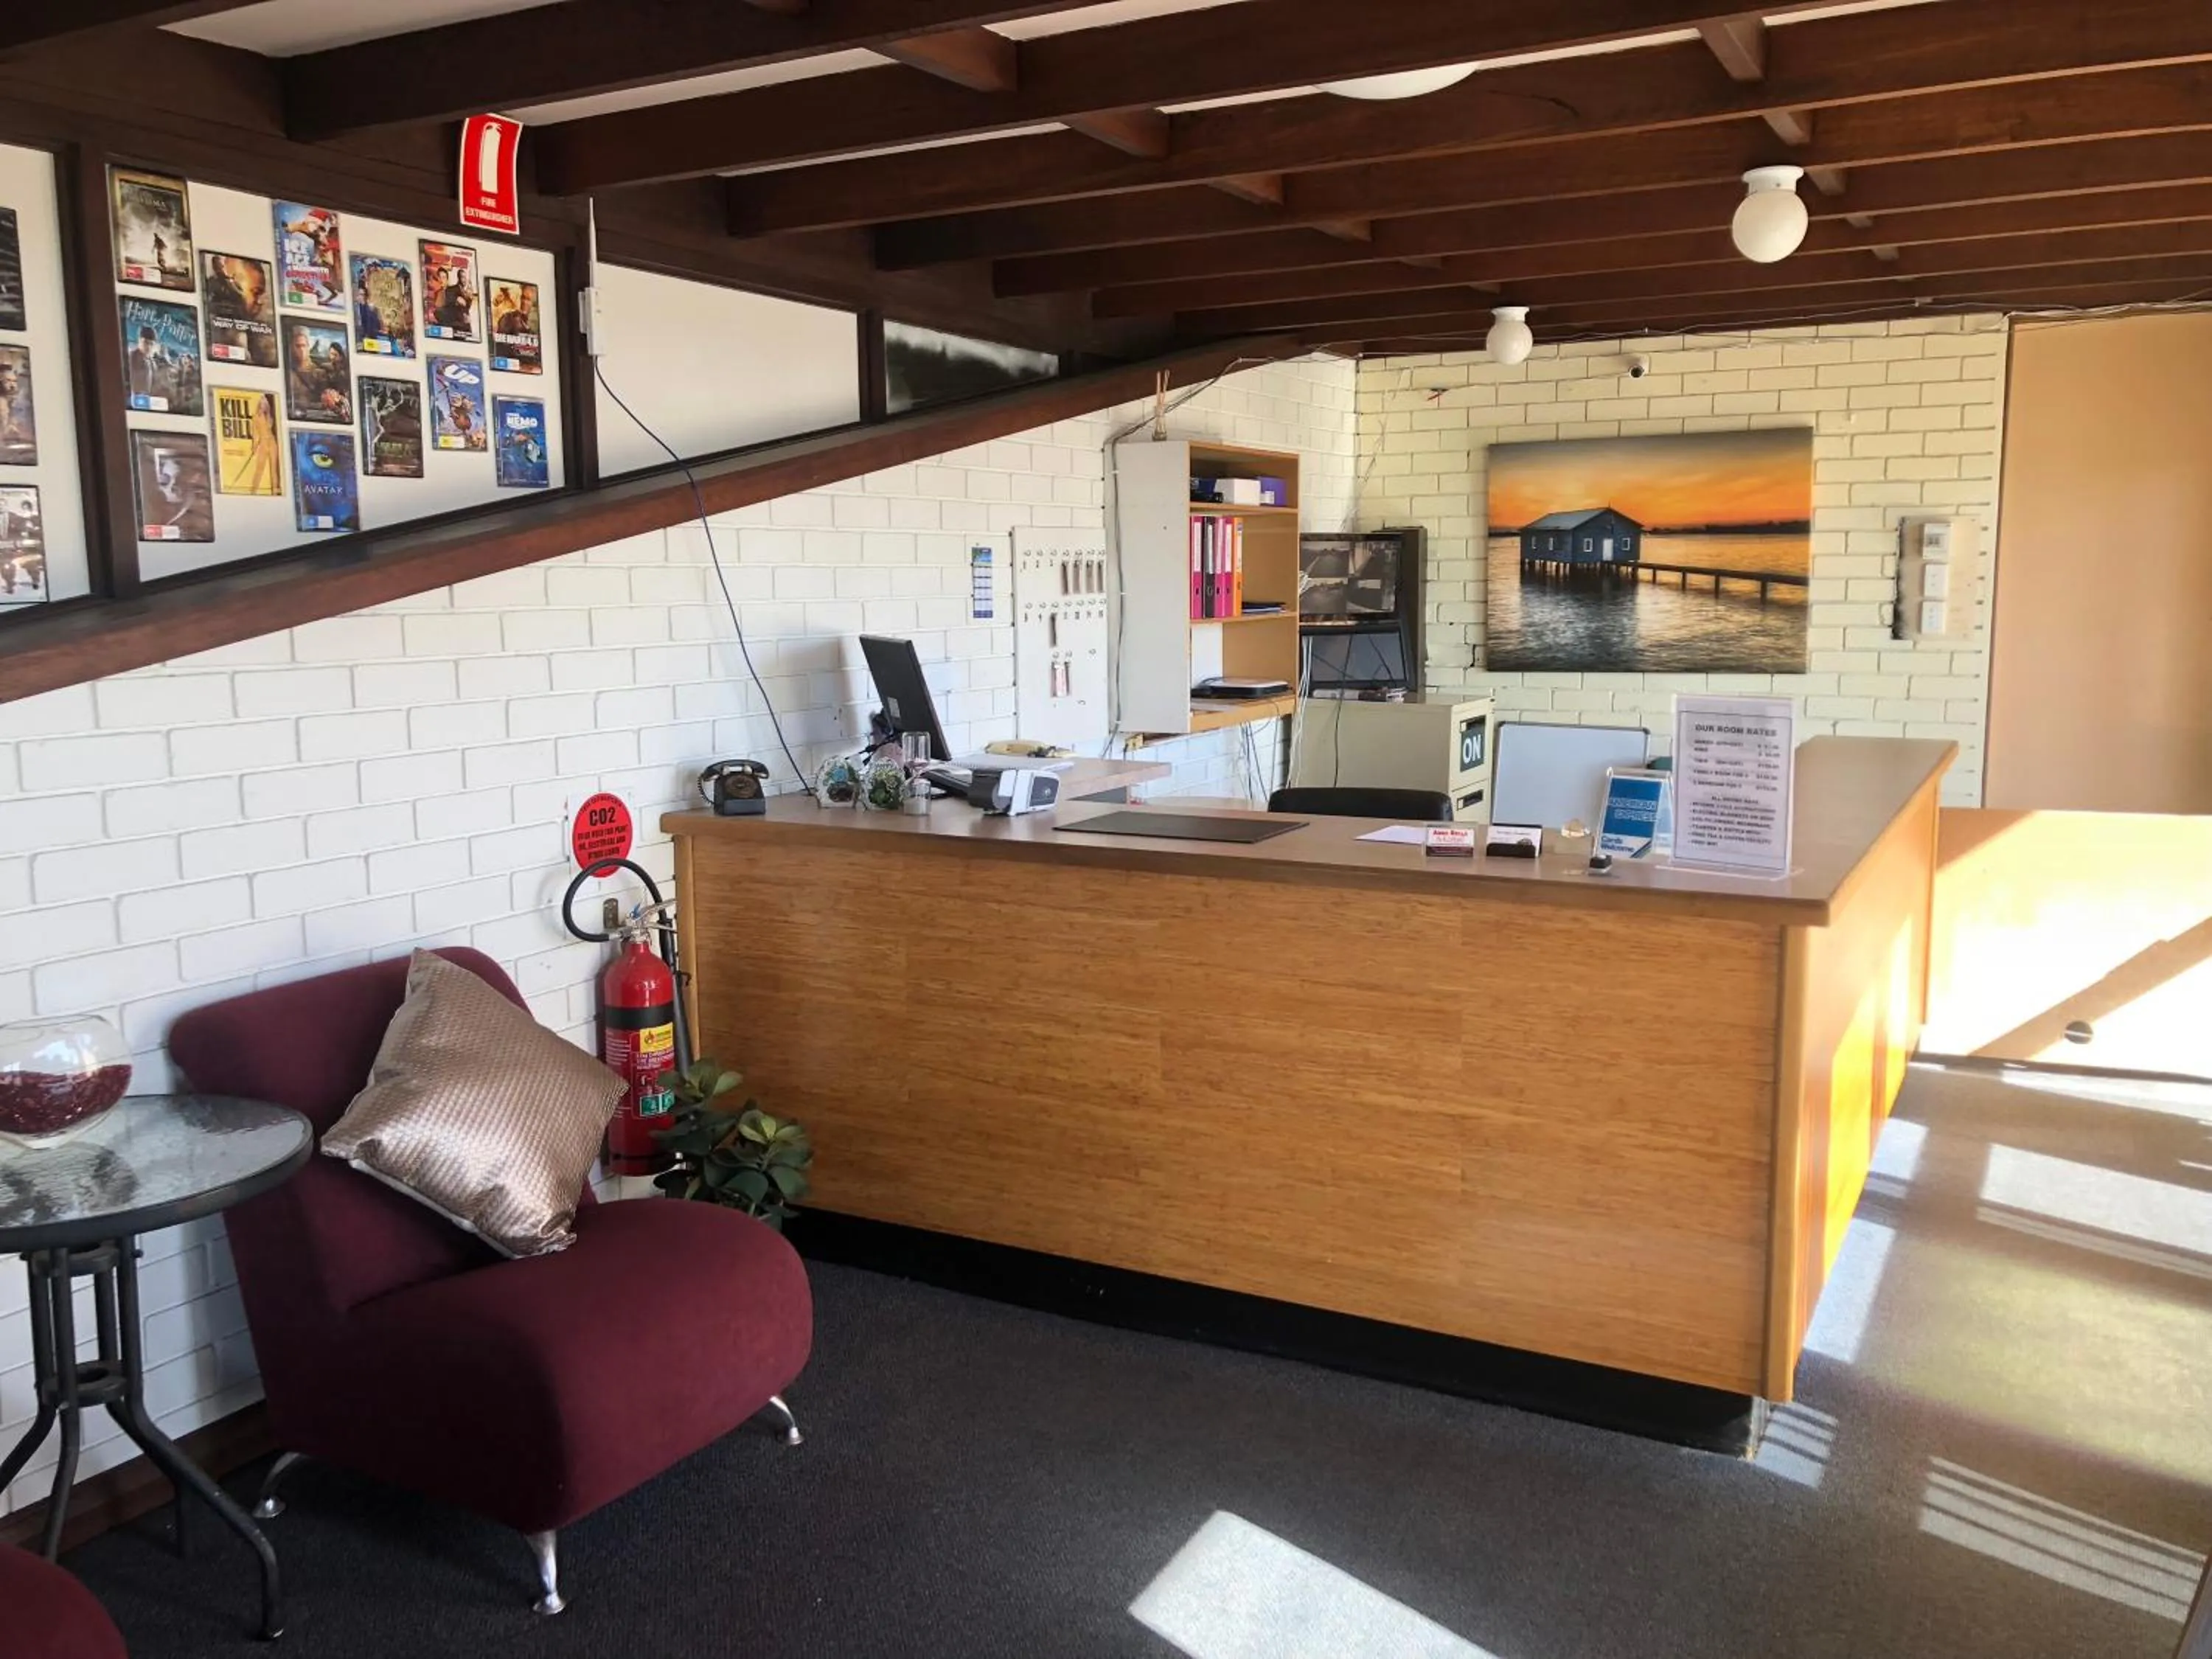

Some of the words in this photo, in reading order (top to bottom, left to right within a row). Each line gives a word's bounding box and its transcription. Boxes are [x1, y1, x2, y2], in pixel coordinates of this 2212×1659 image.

[481, 197, 496, 209] FIRE
[465, 206, 514, 225] EXTINGUISHER
[444, 364, 480, 384] UP
[220, 398, 252, 419] KILL
[222, 418, 253, 439] BILL
[507, 416, 538, 428] NEMO
[305, 484, 343, 495] AVATAR
[1695, 724, 1715, 733] OUR
[1717, 725, 1744, 734] ROOM
[1747, 727, 1778, 737] RATES
[1463, 734, 1481, 764] ON
[589, 806, 616, 827] CO2
